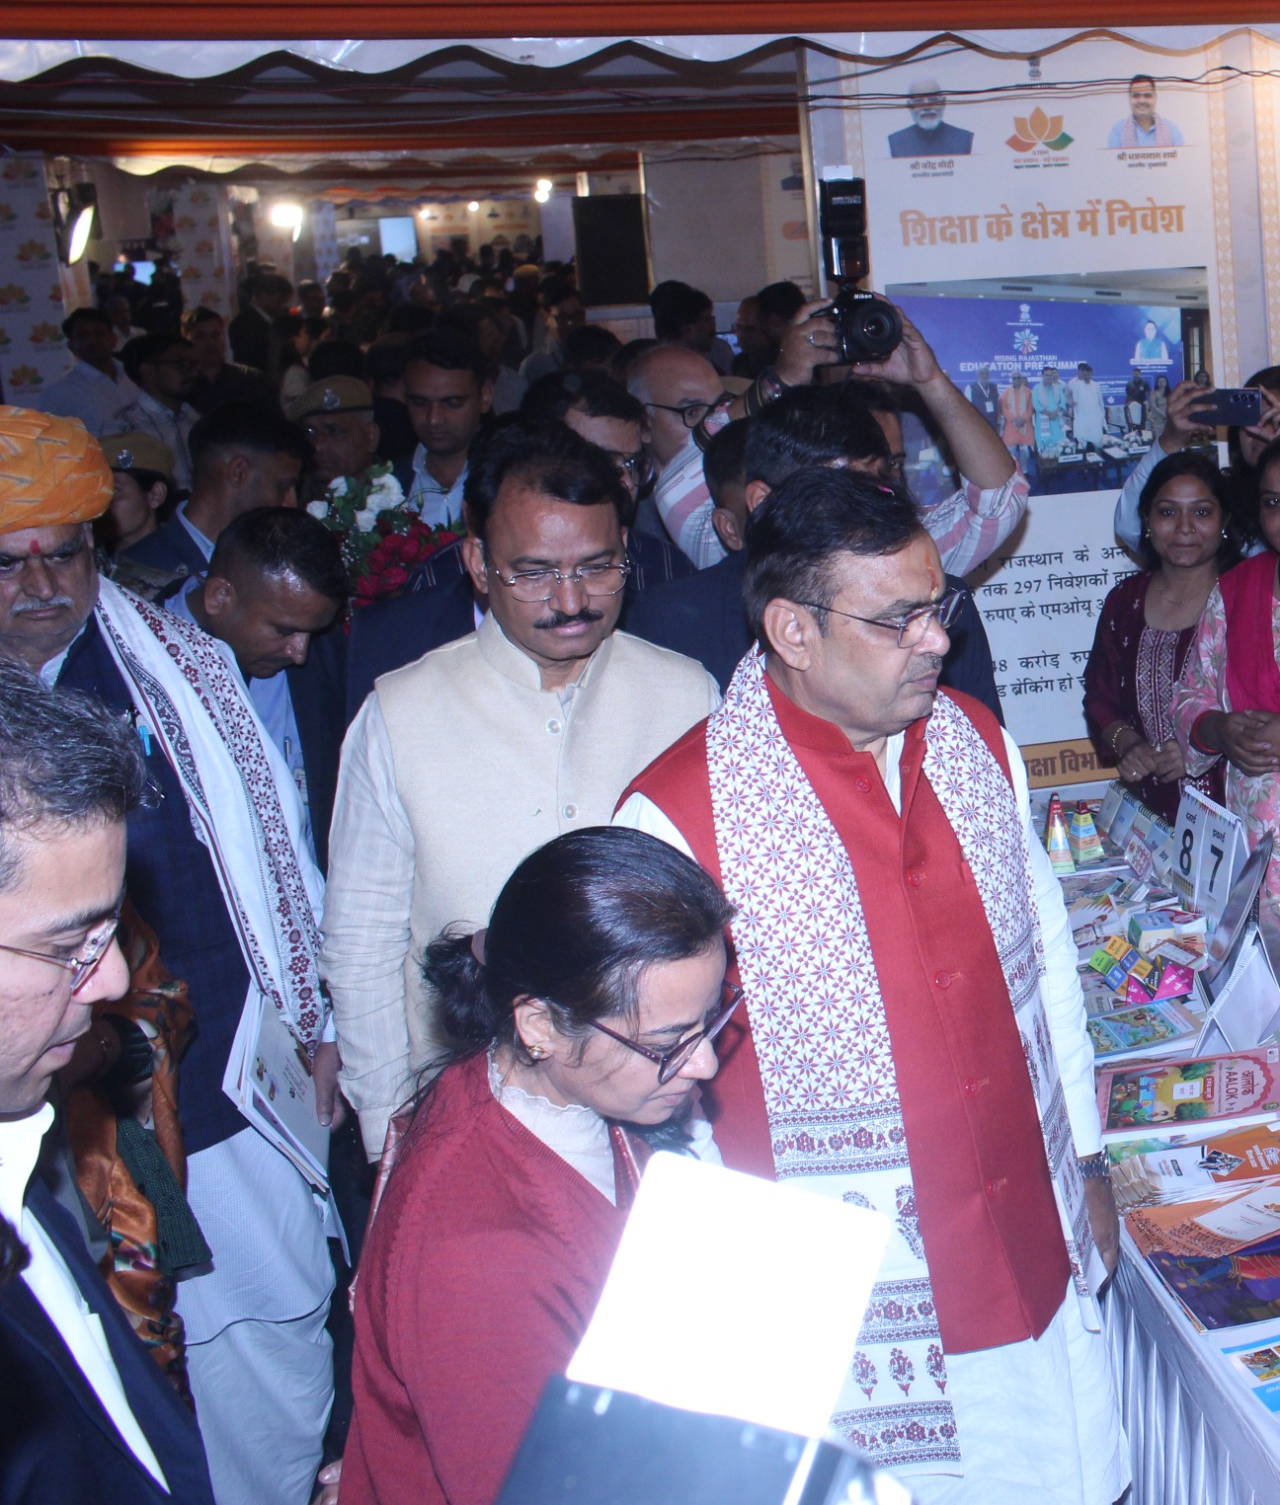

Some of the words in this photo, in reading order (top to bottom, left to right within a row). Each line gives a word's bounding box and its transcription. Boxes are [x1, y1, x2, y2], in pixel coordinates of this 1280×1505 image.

[899, 209, 979, 247] शिक्षा
[984, 204, 1014, 242] के
[1020, 202, 1071, 241] क्षेत्र
[1075, 199, 1102, 237] में
[1105, 196, 1185, 236] निवेश
[853, 292, 873, 300] Nikon
[1018, 354, 1058, 362] RAJASTHAN
[1024, 360, 1087, 371] PRE-SUMM
[998, 551, 1064, 570] राजस्थान
[1073, 544, 1090, 563] के
[981, 582, 1008, 597] तक
[1014, 579, 1043, 595] 297
[1047, 568, 1109, 591] निवेशकों
[983, 607, 1018, 624] रुपए
[1019, 601, 1036, 618] के
[1039, 596, 1096, 620] एमओयू
[1017, 650, 1061, 669] करोड़
[1070, 650, 1092, 664] रुप
[1010, 676, 1054, 696] ब्रेकिंग
[1057, 672, 1074, 693] हो
[1179, 828, 1194, 876] 8
[1208, 844, 1224, 893] 7
[1225, 1071, 1239, 1100] AALOK
